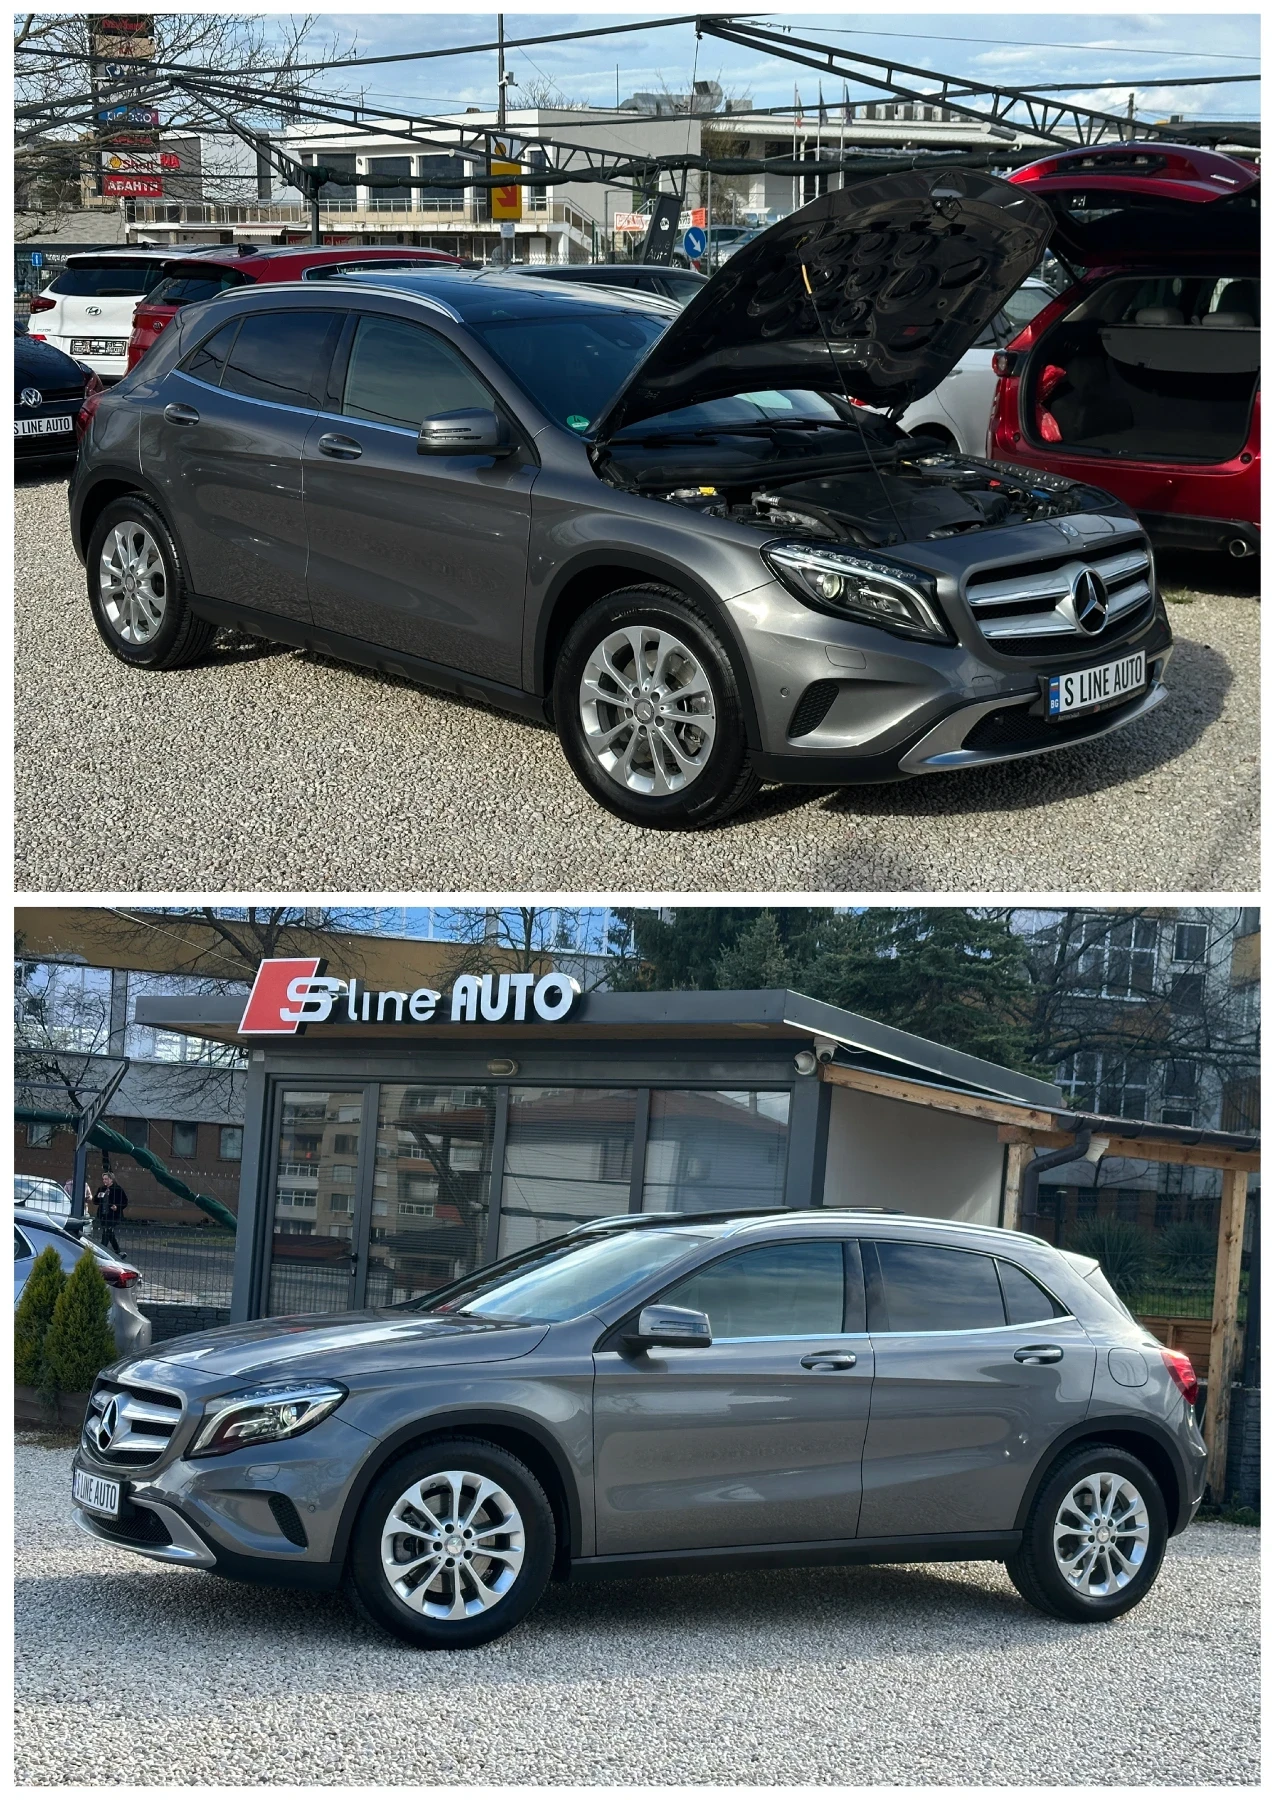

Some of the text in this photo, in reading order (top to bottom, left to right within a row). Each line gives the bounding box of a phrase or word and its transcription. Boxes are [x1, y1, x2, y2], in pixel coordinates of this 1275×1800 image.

[22, 420, 43, 434] LINE
[46, 418, 70, 431] AUTO
[1064, 677, 1074, 707] S
[1080, 667, 1110, 703] LINE
[1113, 655, 1143, 693] AUTO
[1050, 699, 1059, 709] BG
[279, 972, 576, 1022] S line AUTO
[80, 1474, 94, 1503] LINE
[94, 1480, 117, 1510] AUTO
